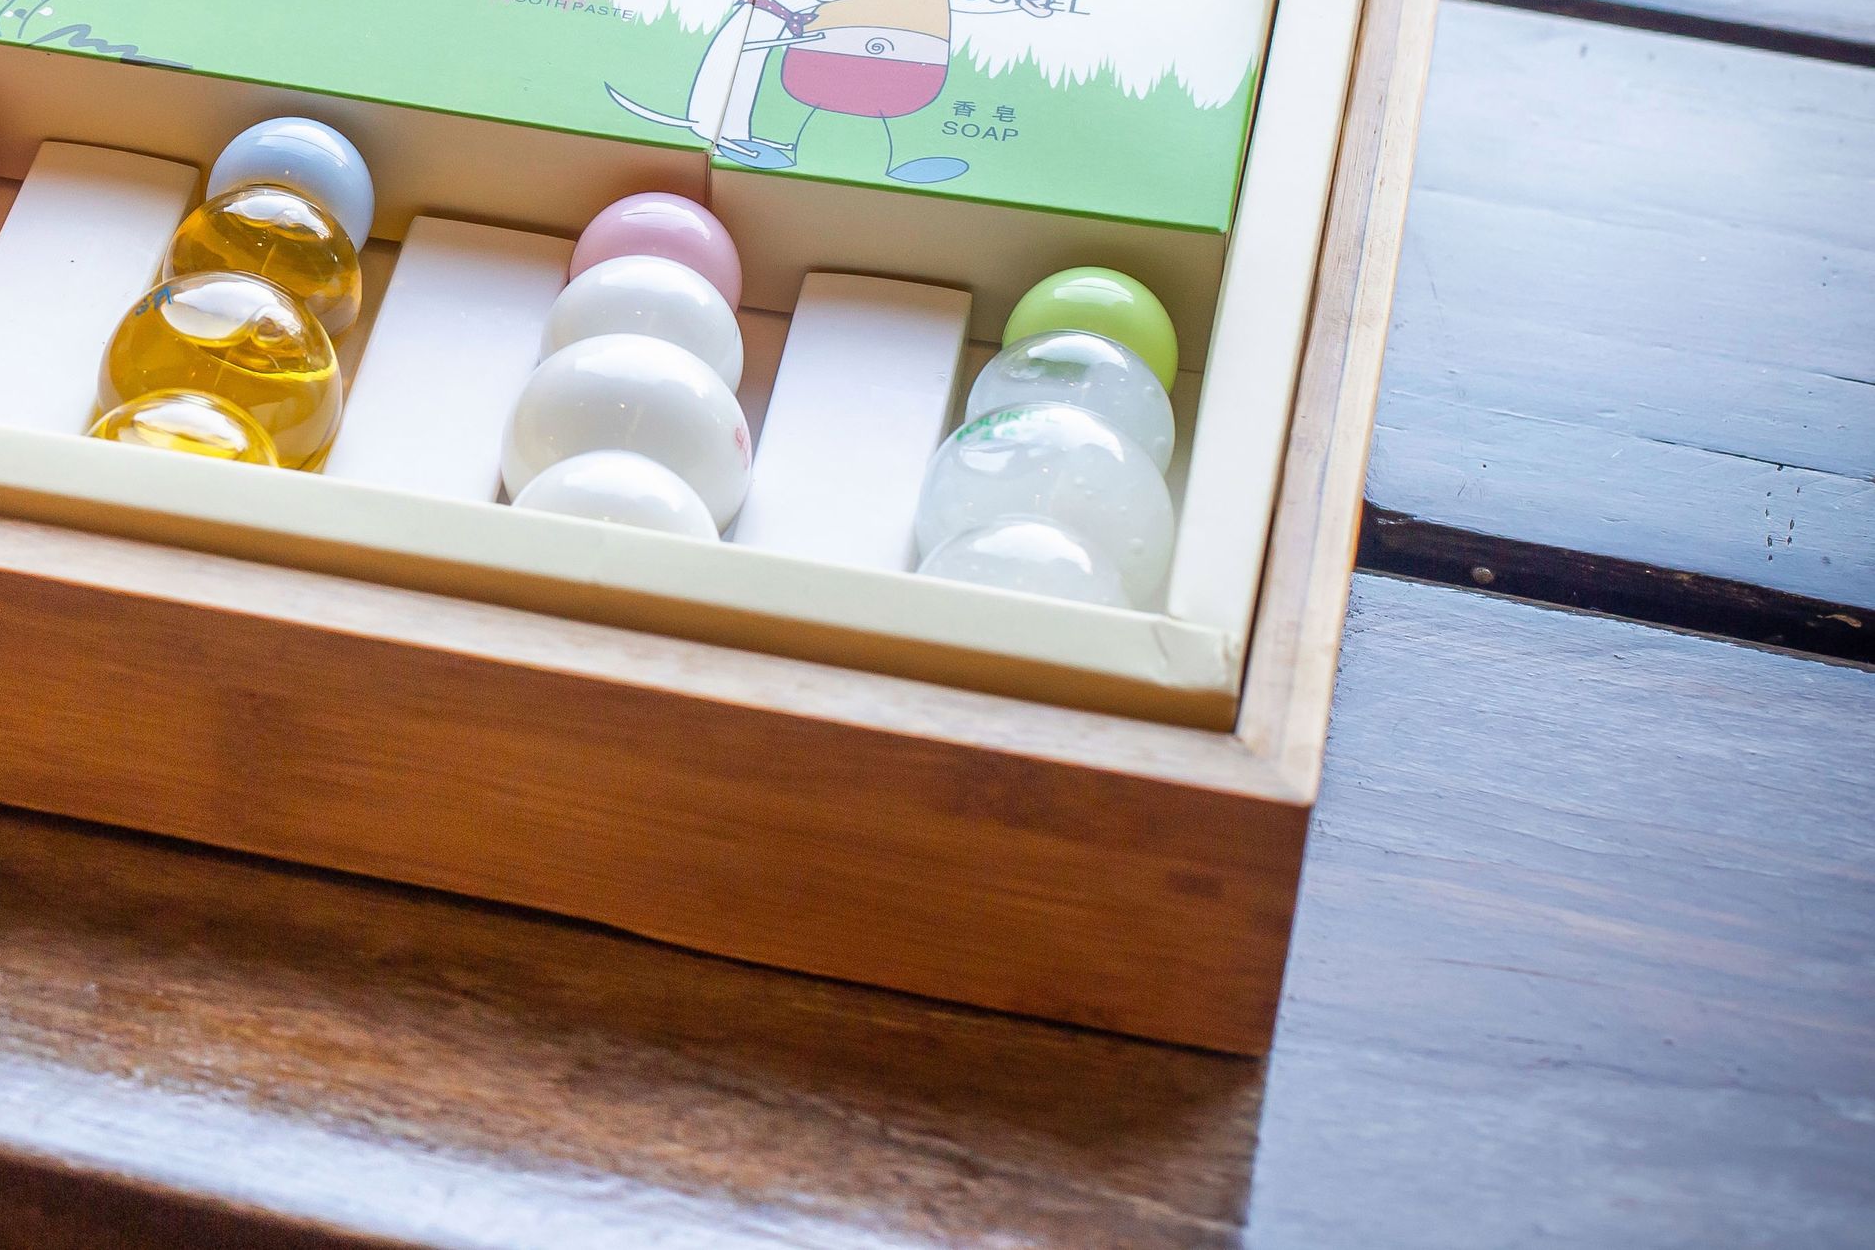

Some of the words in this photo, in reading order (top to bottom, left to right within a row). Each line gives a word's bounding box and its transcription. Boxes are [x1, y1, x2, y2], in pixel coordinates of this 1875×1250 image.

[573, 2, 634, 19] PASTE
[952, 100, 1017, 123] 香皂
[941, 121, 1018, 141] SOAP
